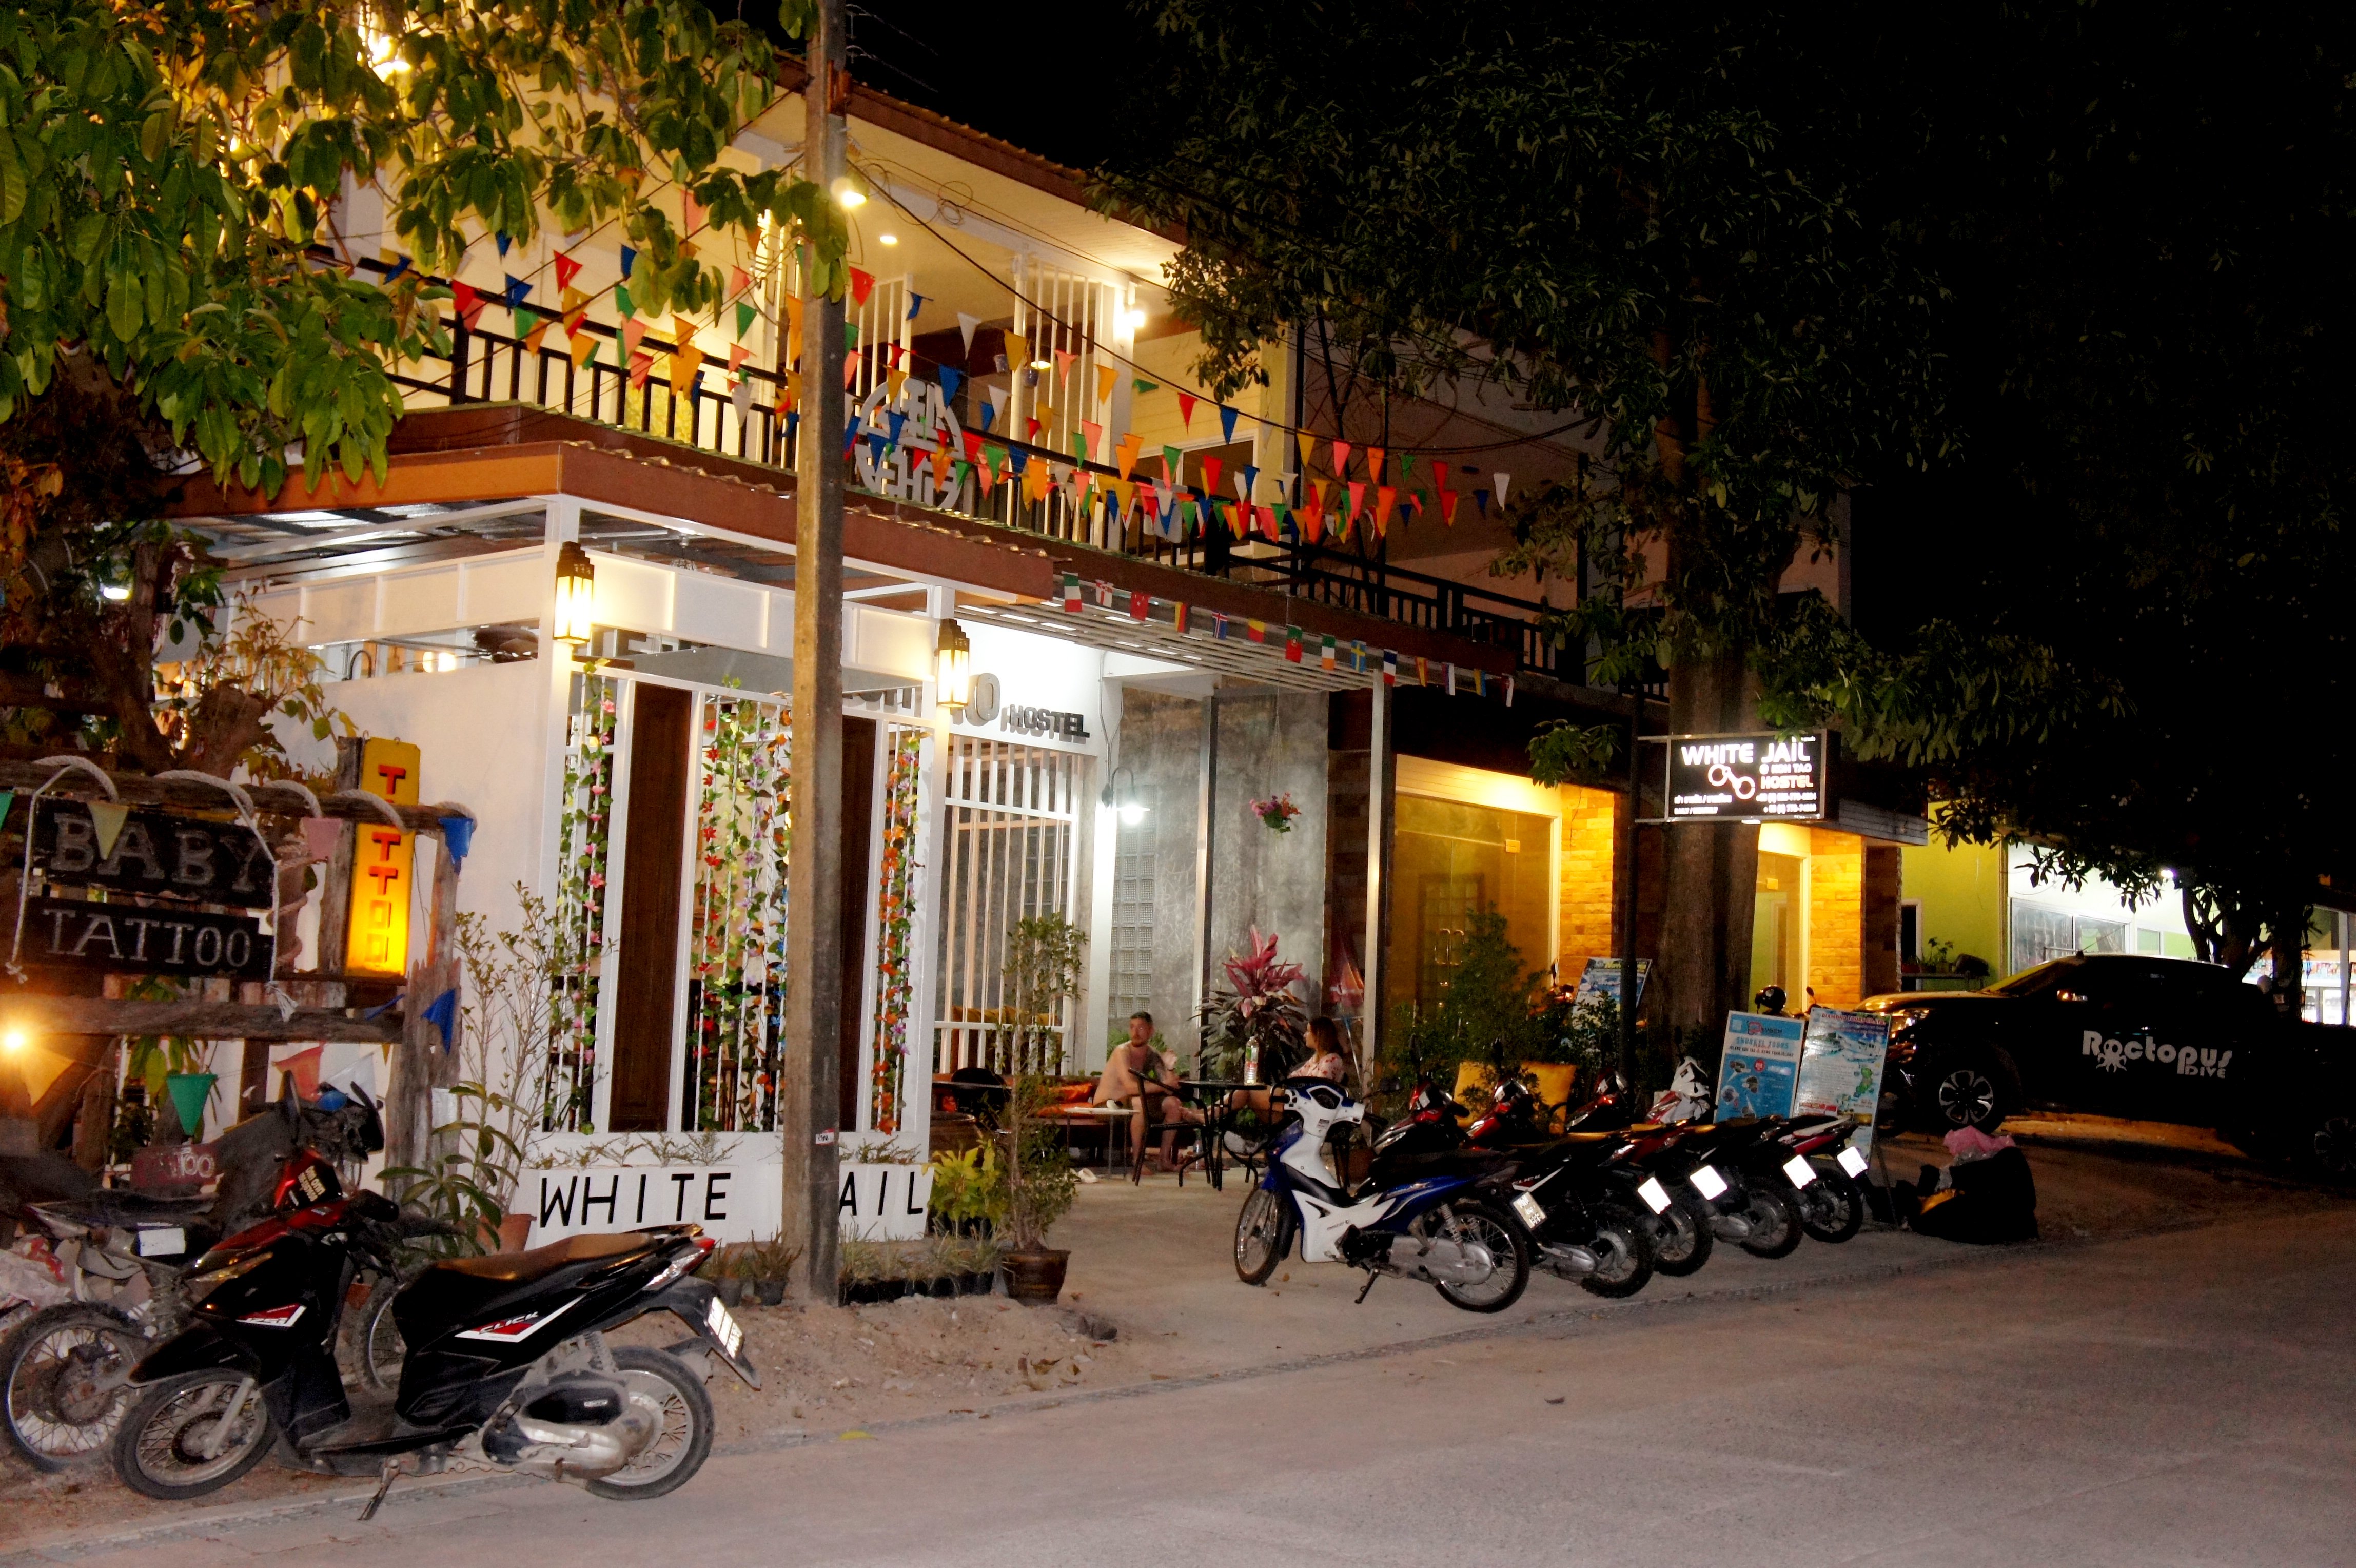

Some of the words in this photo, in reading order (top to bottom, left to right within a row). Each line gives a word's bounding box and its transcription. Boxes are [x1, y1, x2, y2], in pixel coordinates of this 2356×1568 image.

[1009, 704, 1090, 738] HOSTEL
[1681, 743, 1754, 766] WHITE
[1761, 742, 1811, 763] JAIL
[1792, 763, 1812, 773] TAO
[1760, 775, 1814, 789] HOSTEL
[50, 812, 262, 892] BABY
[364, 764, 406, 963] TTTOO
[43, 908, 251, 967] TATTOO
[2185, 1064, 2226, 1078] DIVE
[540, 1172, 731, 1228] WHITE
[839, 1171, 924, 1216] AIL
[479, 1311, 539, 1335] CLICK
